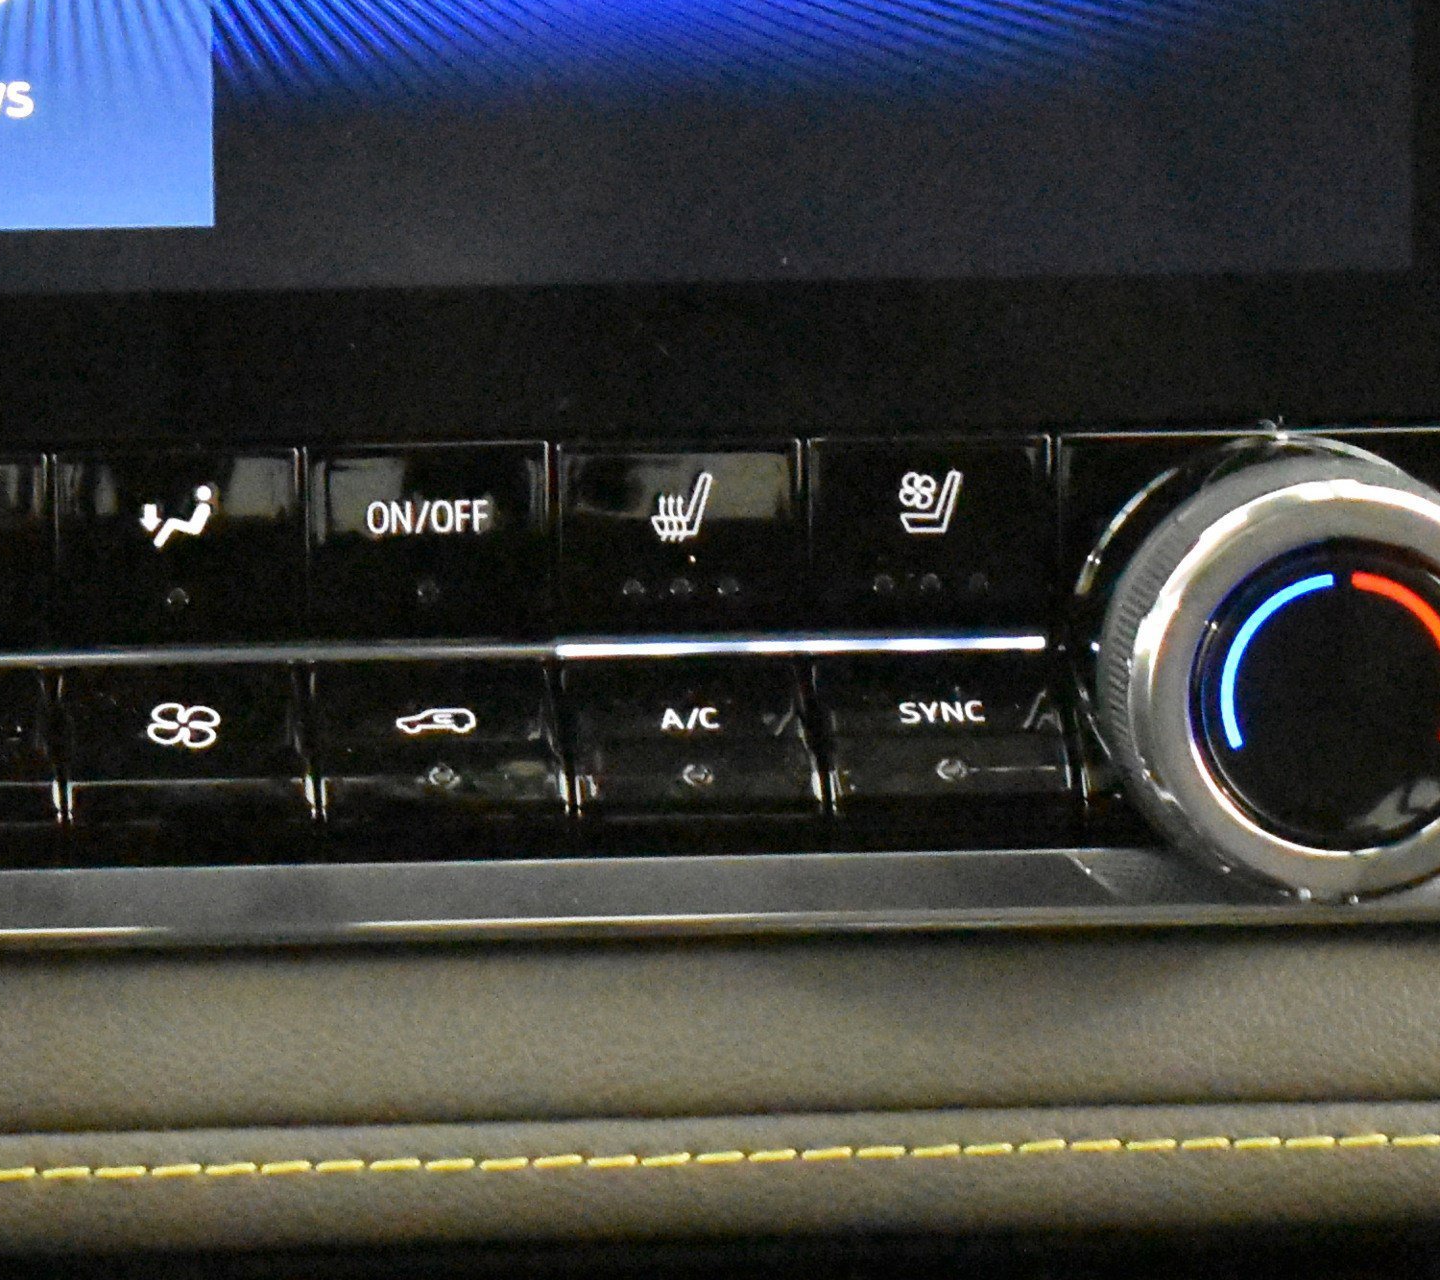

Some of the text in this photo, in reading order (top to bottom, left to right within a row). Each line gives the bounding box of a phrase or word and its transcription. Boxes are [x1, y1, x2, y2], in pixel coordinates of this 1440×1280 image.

[366, 499, 489, 535] ON/OFF
[660, 706, 721, 731] A/C
[898, 699, 986, 725] SYNC
